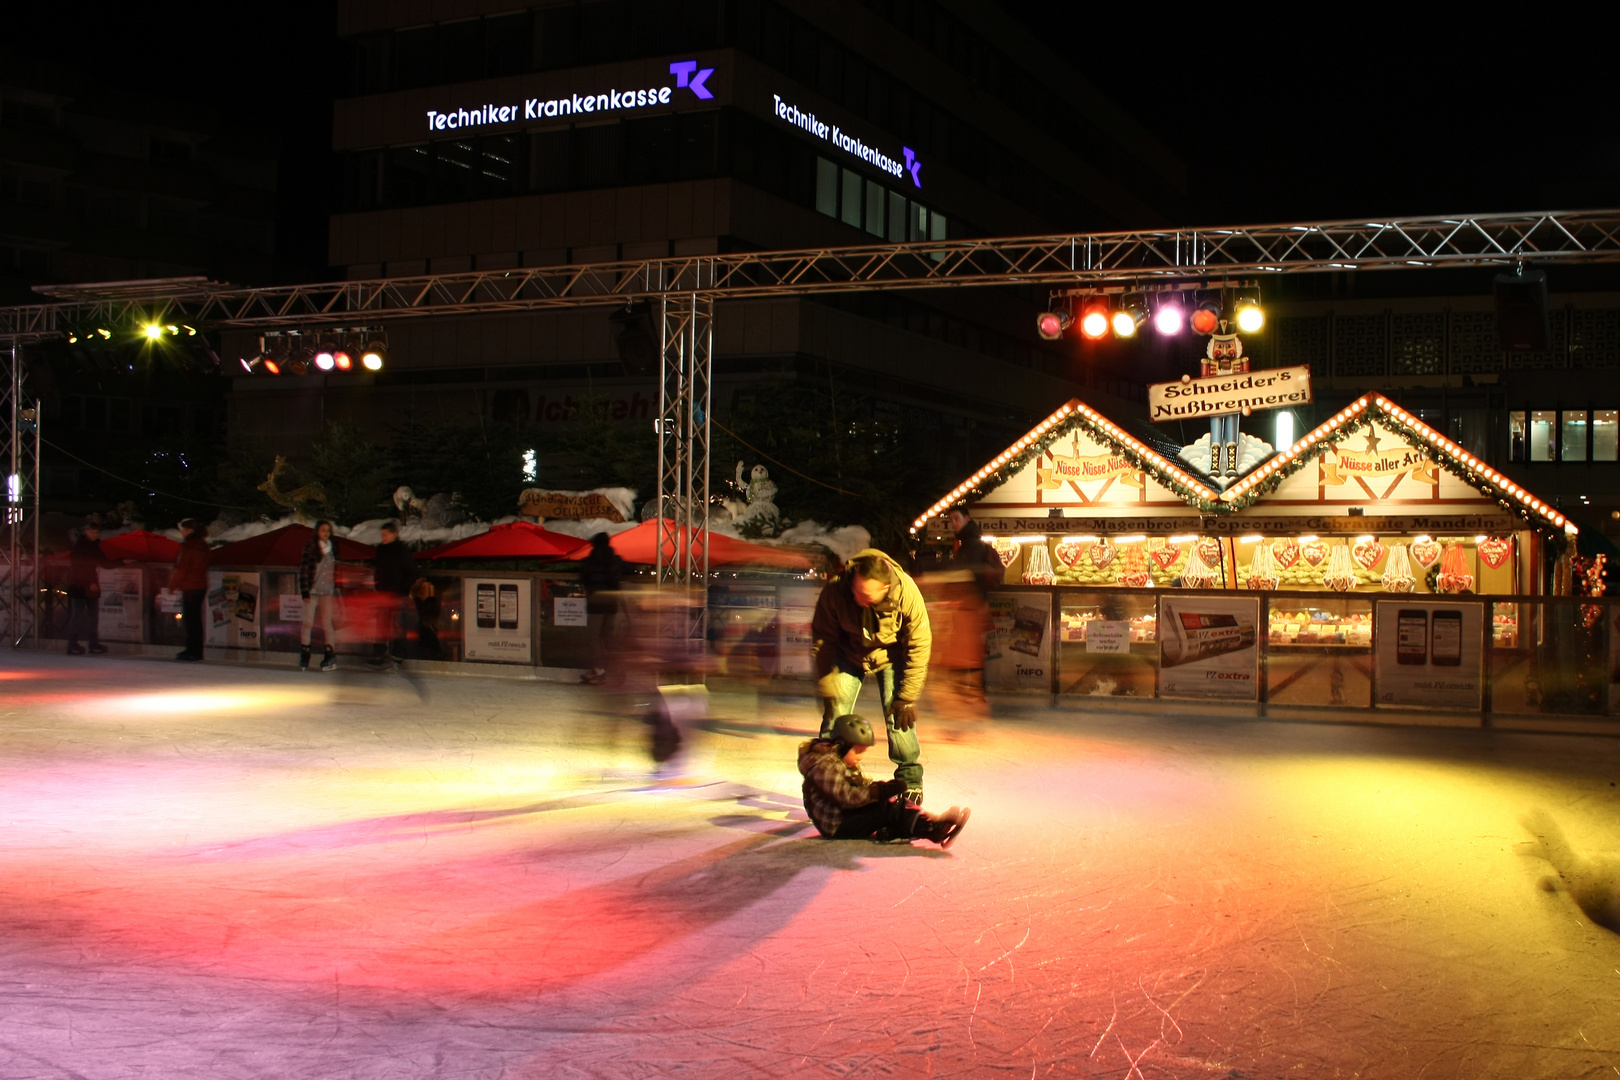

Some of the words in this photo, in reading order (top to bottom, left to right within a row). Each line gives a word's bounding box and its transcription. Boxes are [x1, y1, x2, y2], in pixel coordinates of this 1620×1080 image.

[427, 103, 518, 131] Techniker
[525, 86, 672, 119] Krankenkasse
[773, 93, 829, 141] Techniker
[832, 124, 903, 179] Krankenkasse
[1164, 371, 1291, 399] Schneider's
[1153, 389, 1307, 418] Nußbrennerei
[1055, 460, 1080, 476] Nüsse
[1082, 461, 1106, 476] Nüsse
[1339, 455, 1372, 472] Nüsse
[1374, 458, 1399, 472] aller
[1402, 451, 1424, 467] Art
[941, 519, 1008, 530] Tisch
[1014, 519, 1070, 533] Nougat
[1092, 519, 1178, 532] Magenbrot
[1203, 519, 1285, 532] Popcorn
[1306, 517, 1404, 530] Gebrannte
[1410, 516, 1495, 529] Mandeln
[1211, 629, 1241, 637] extra
[1016, 667, 1043, 677] INFO
[1206, 671, 1217, 679] PZ
[1218, 672, 1250, 681] extra
